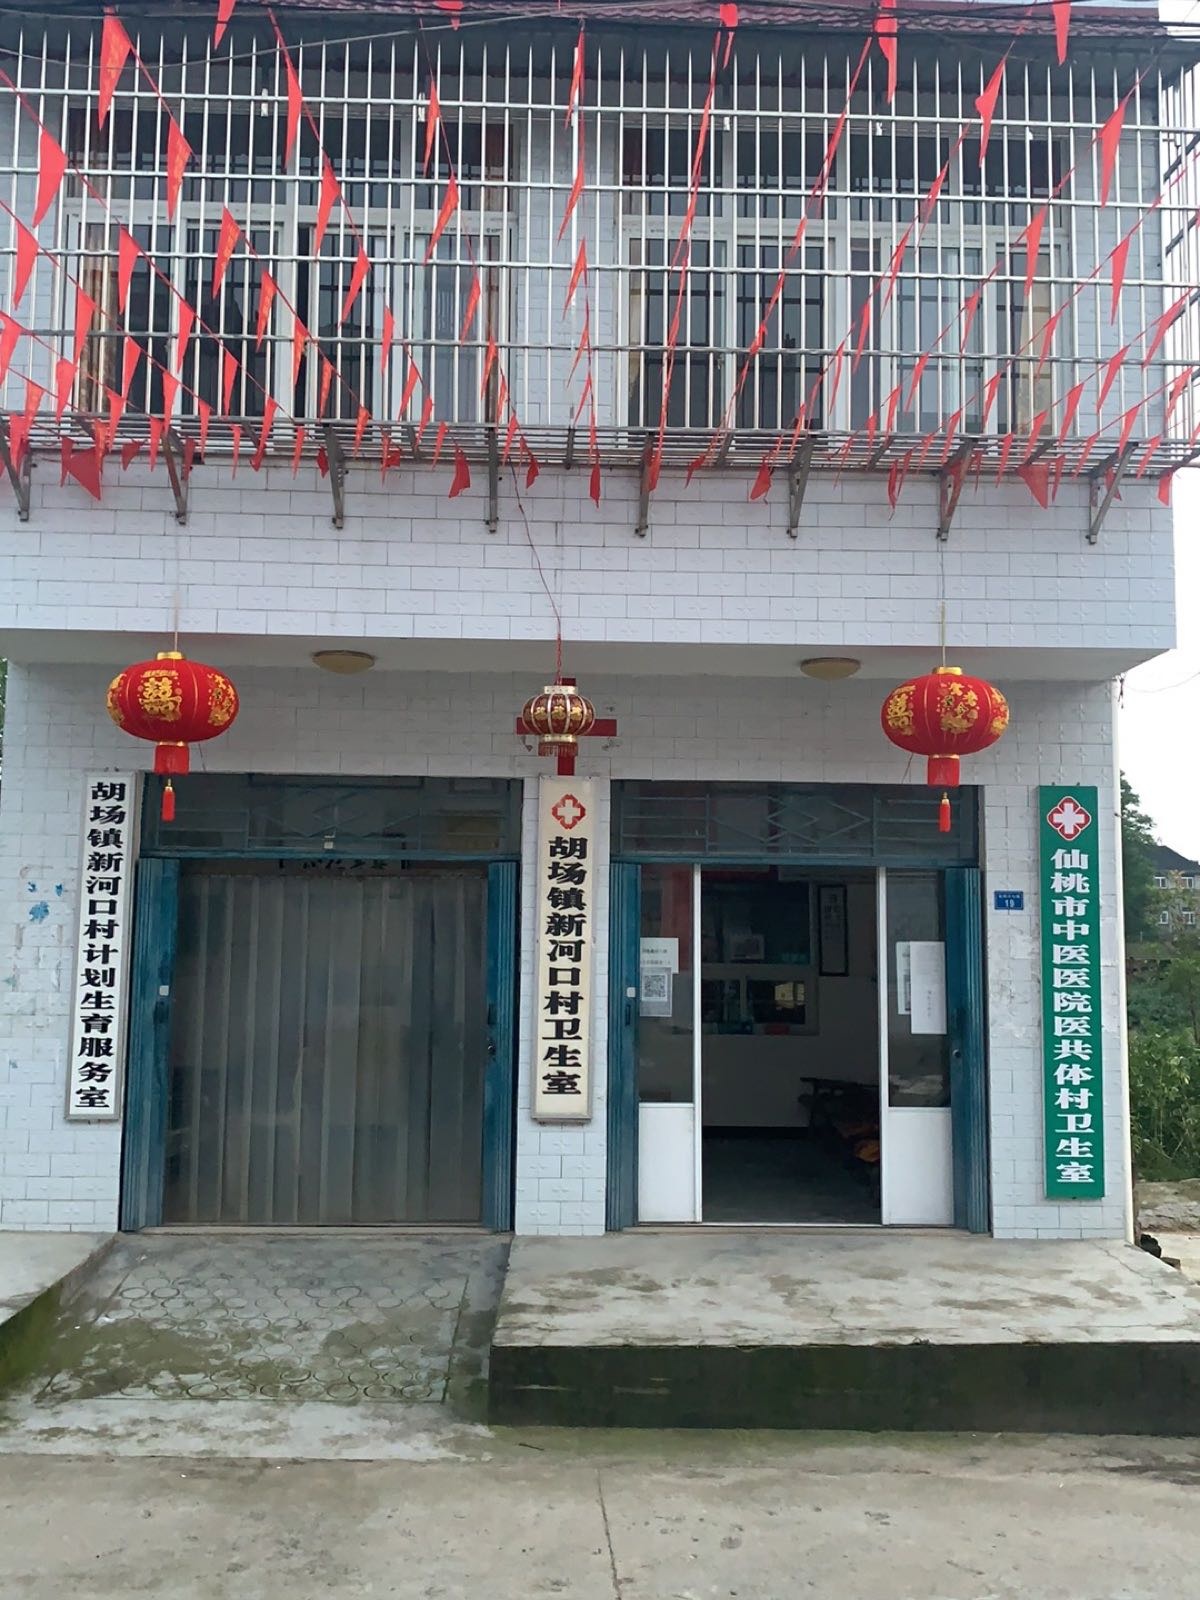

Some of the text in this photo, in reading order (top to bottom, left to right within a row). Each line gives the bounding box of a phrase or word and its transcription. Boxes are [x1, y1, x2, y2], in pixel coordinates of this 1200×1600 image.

[75, 782, 126, 1108] 胡场镇新河口村计划生育服务室
[542, 836, 588, 1094] 胡场镇新河口村卫生室
[1050, 848, 1095, 1183] 仙桃市中医医院医共体村卫生室
